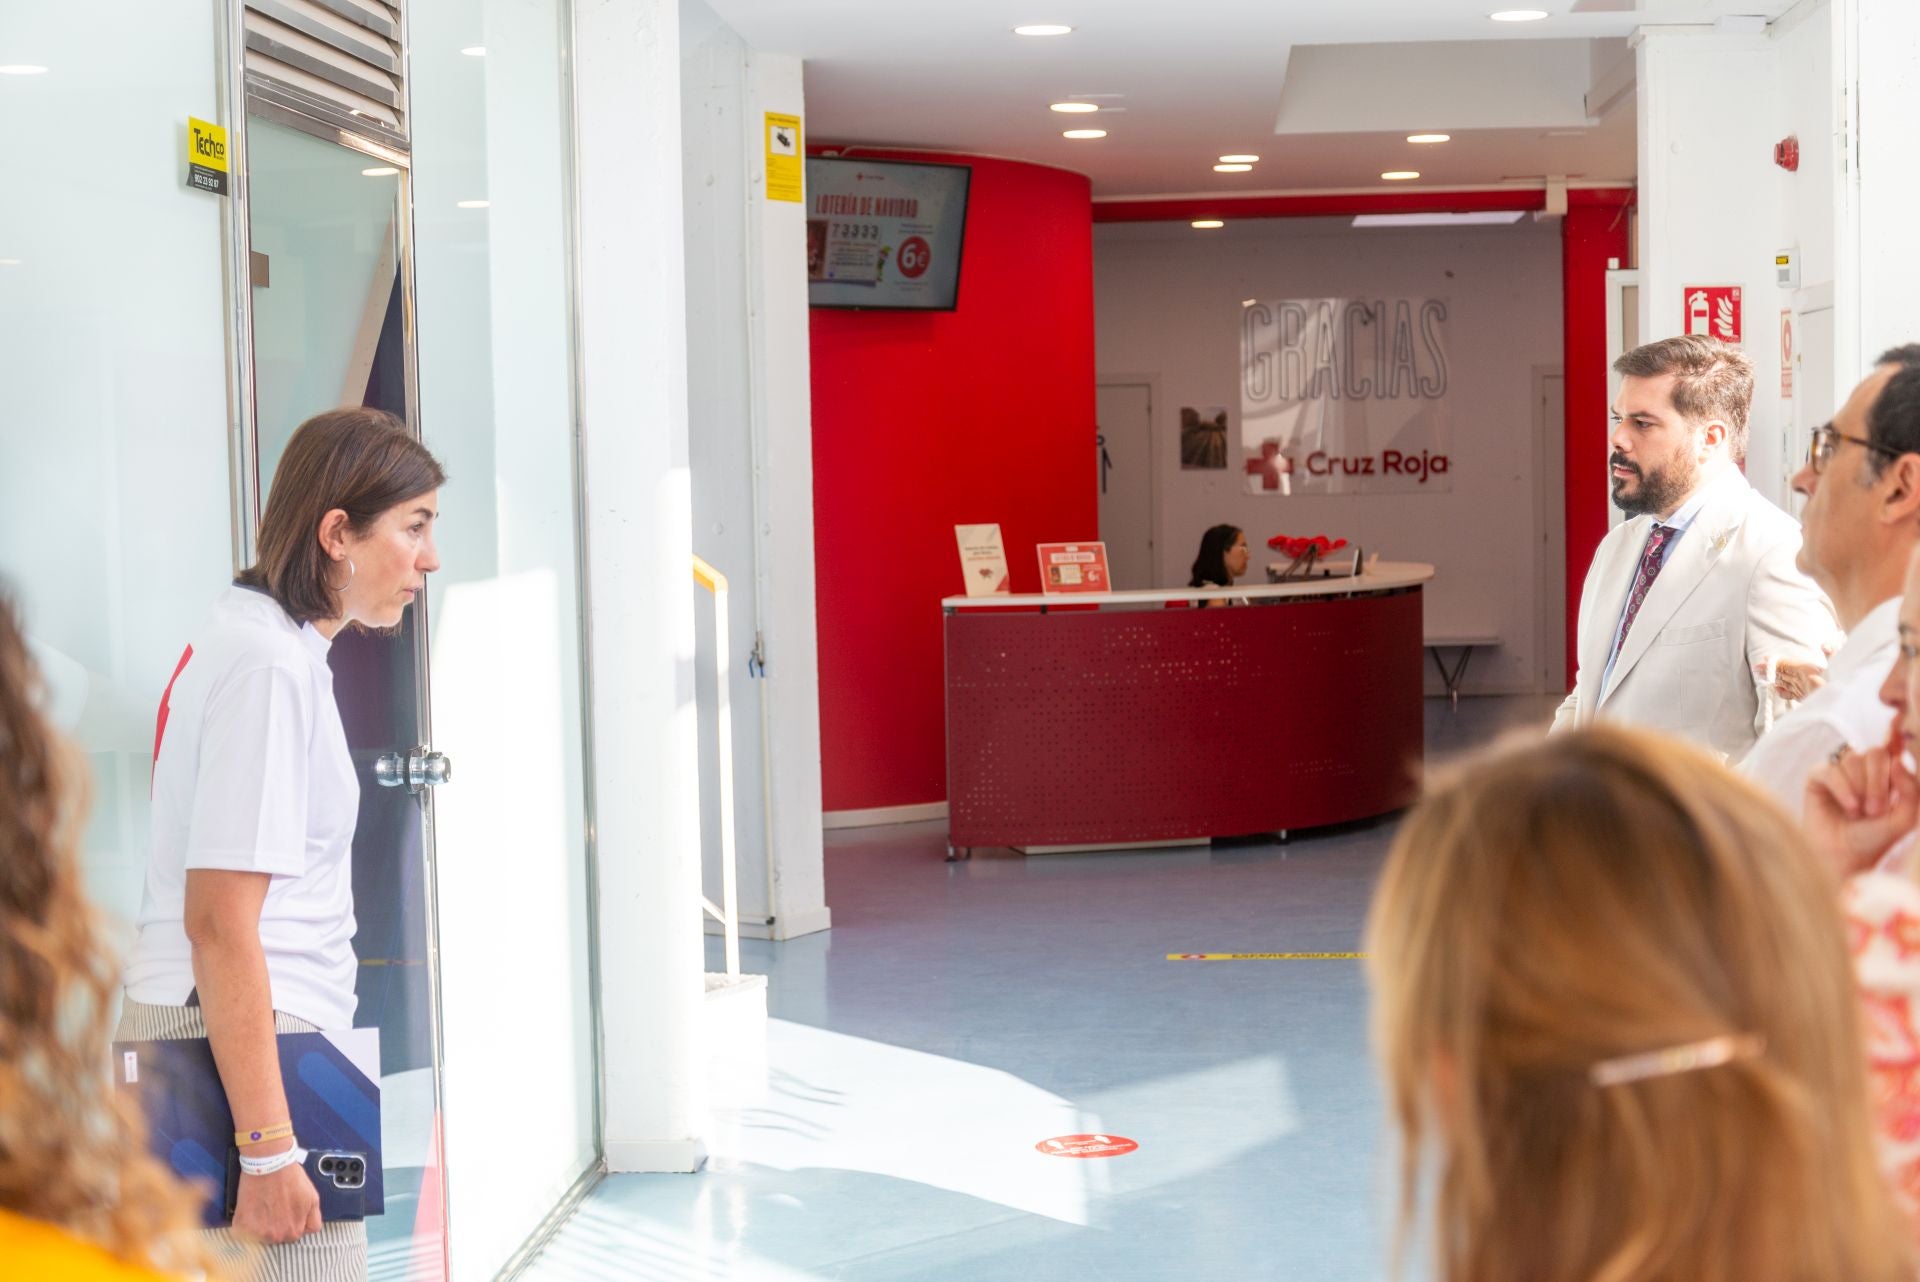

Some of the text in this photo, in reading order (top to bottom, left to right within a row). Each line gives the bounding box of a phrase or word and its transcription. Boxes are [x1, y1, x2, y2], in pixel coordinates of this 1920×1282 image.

[860, 196, 873, 216] DE
[875, 197, 918, 218] NAVIDAD
[1243, 299, 1448, 401] GRACIAS
[1306, 450, 1449, 484] Cruz Roja
